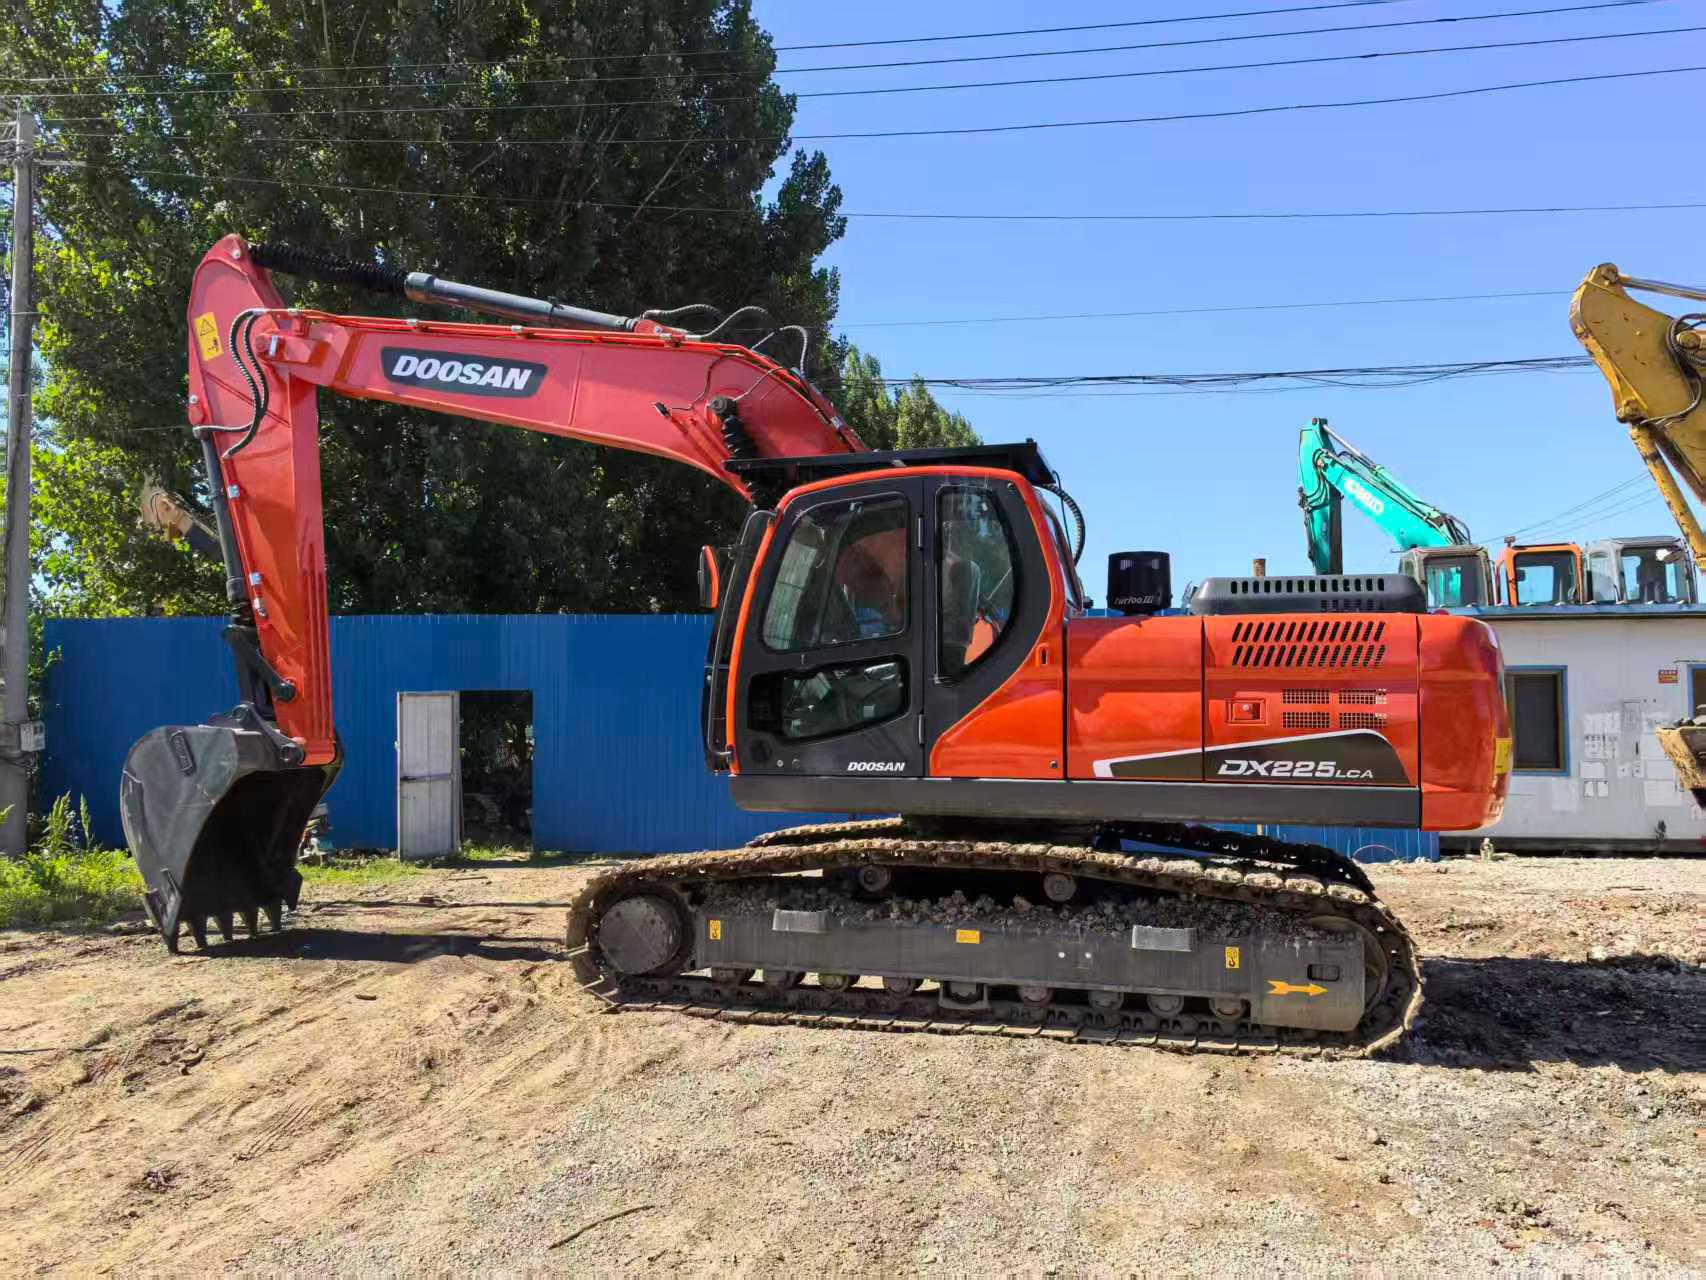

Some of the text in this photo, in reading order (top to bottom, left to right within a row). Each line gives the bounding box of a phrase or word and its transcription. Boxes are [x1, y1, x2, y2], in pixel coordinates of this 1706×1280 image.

[392, 355, 532, 390] DOOSAN
[847, 761, 906, 772] DOOSAN
[1218, 759, 1374, 779] DX225LCA
